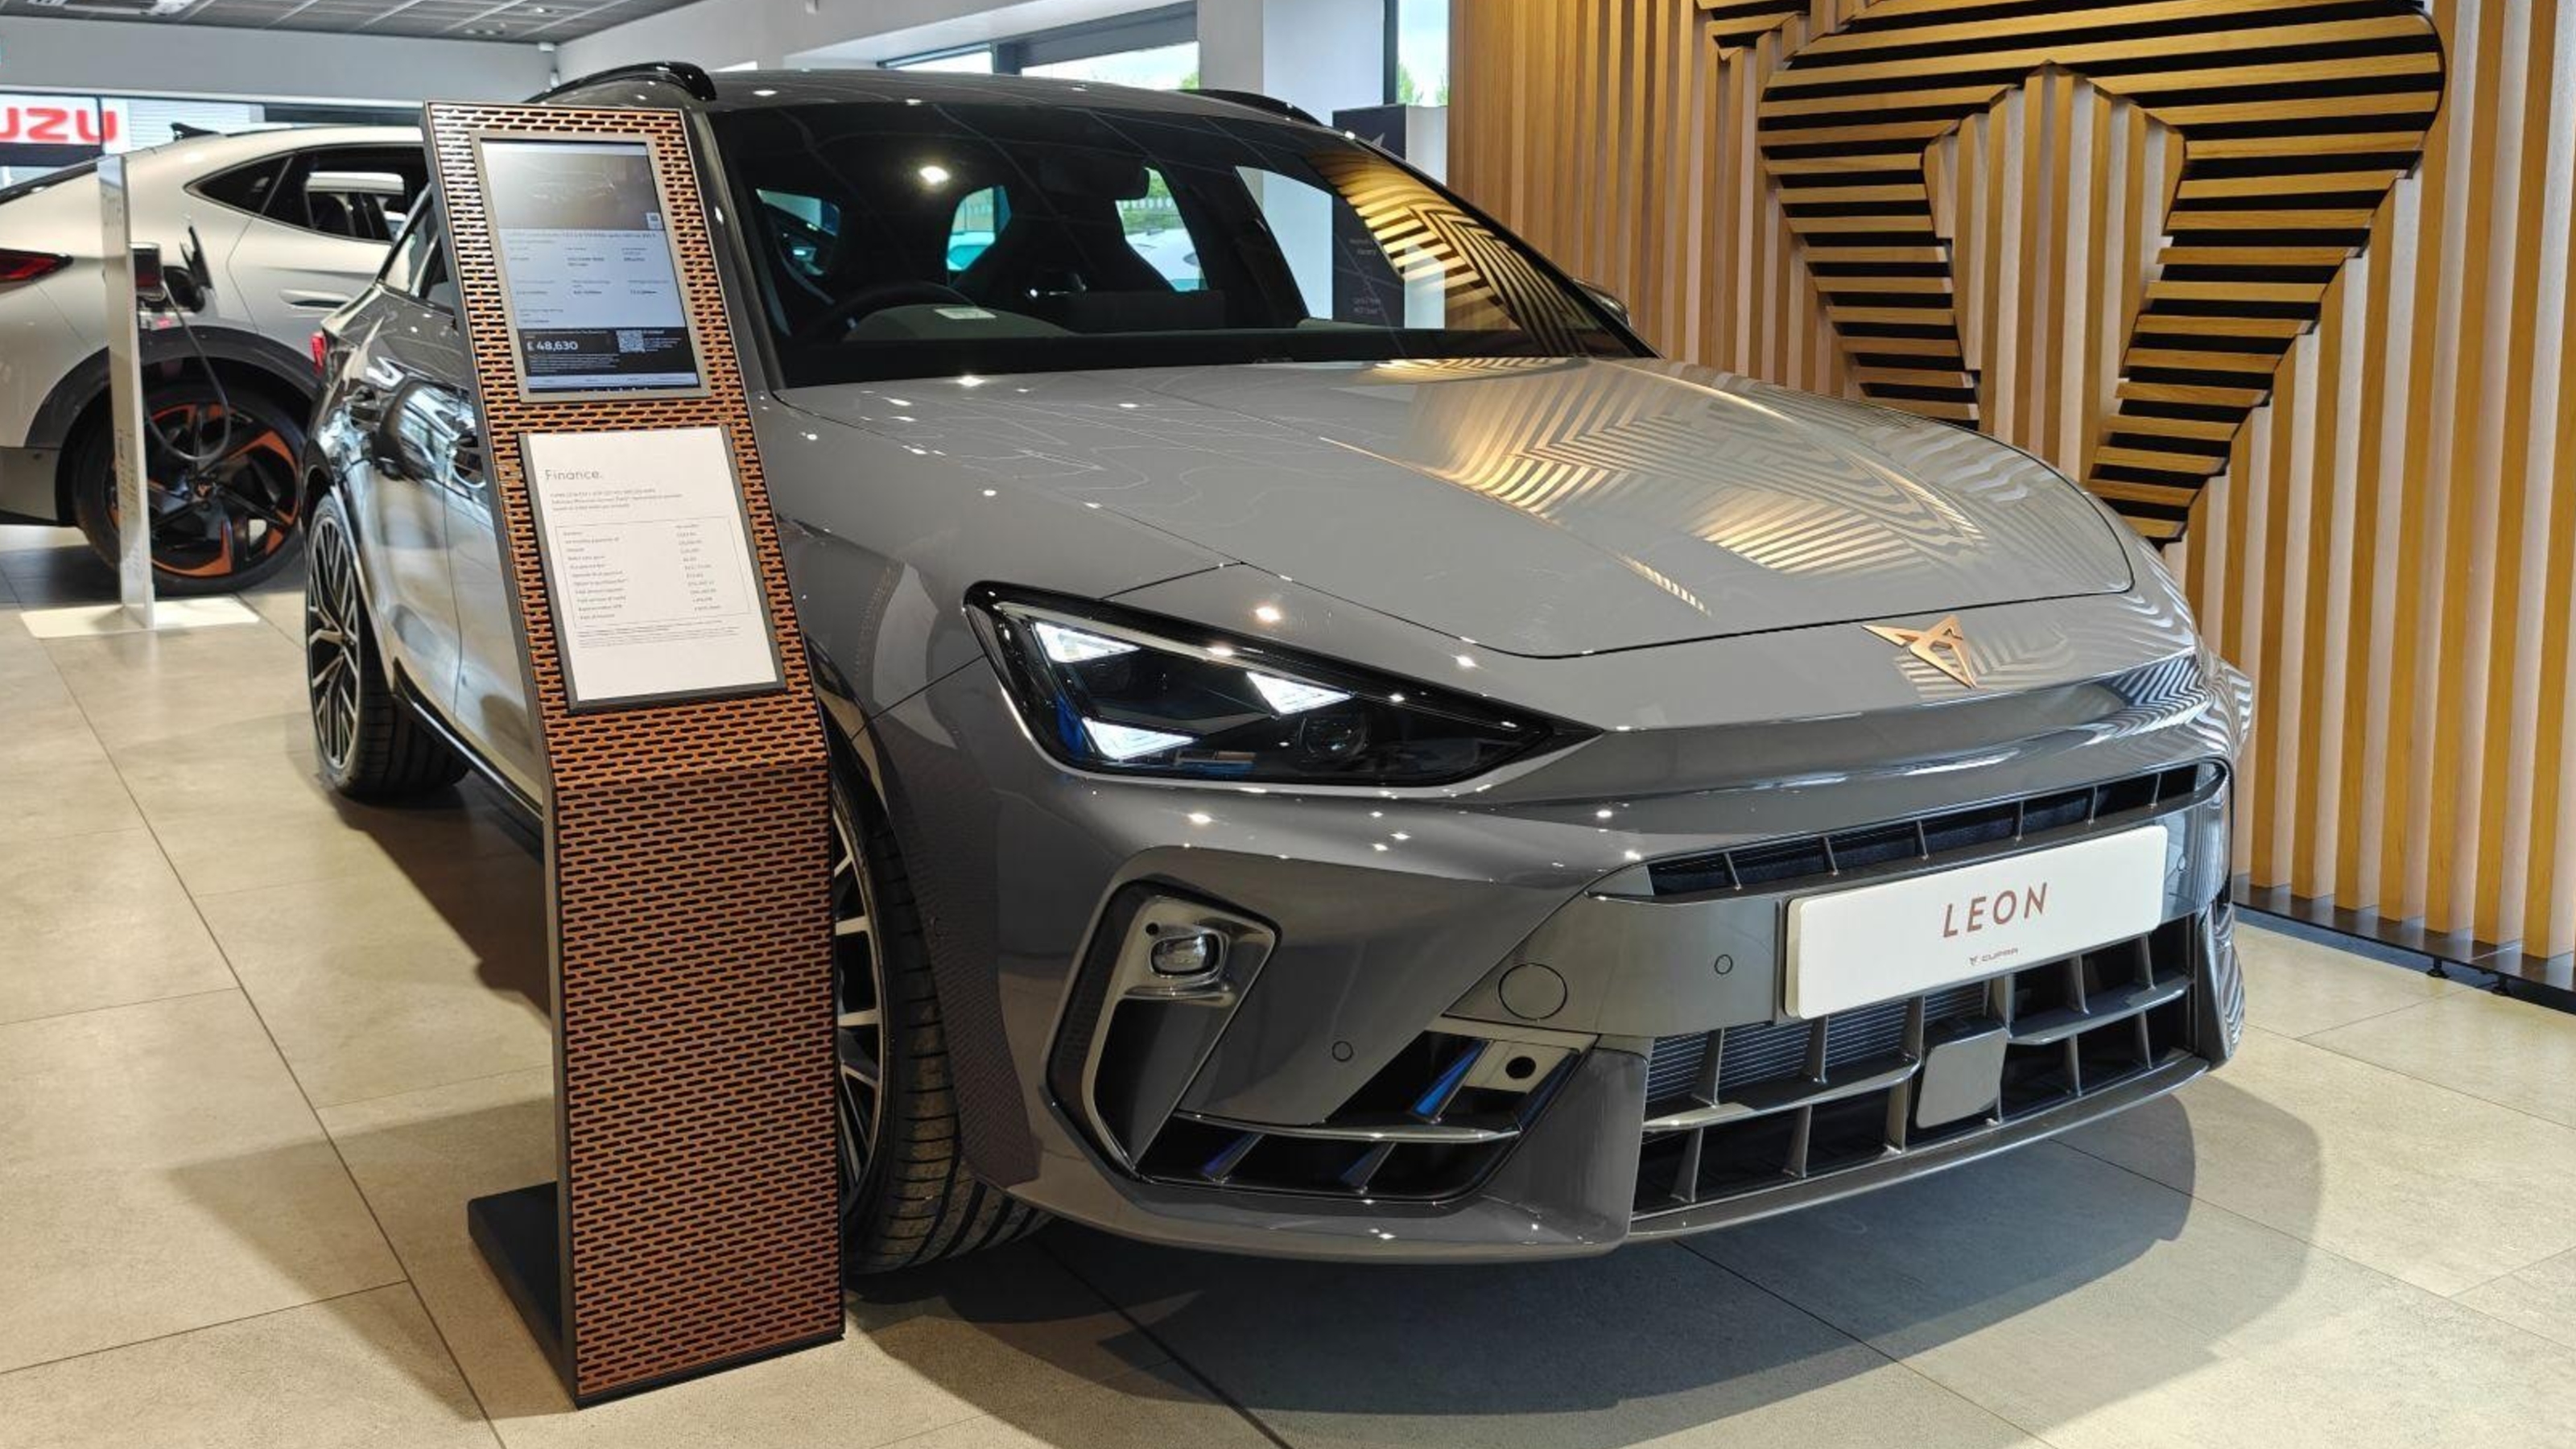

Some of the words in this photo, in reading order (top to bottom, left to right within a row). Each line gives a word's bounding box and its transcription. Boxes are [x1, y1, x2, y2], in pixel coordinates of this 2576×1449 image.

[537, 341, 578, 352] 48,630
[545, 469, 603, 481] Finance.
[1942, 882, 2049, 938] LEON
